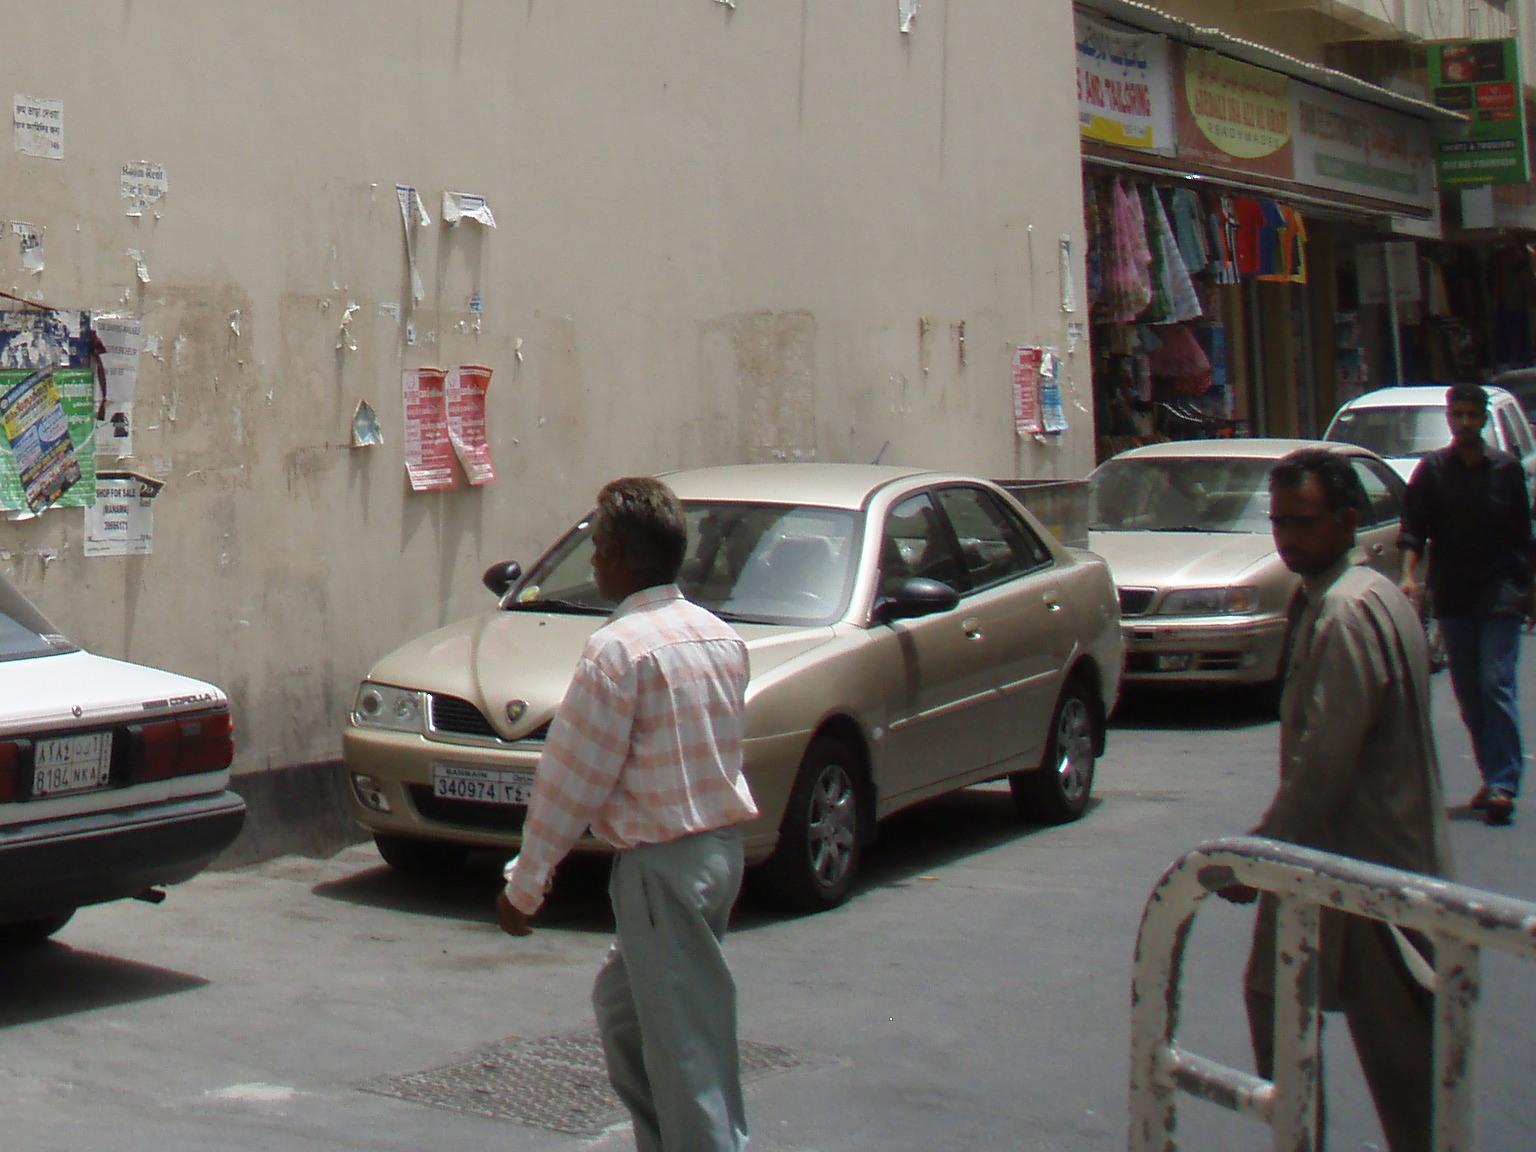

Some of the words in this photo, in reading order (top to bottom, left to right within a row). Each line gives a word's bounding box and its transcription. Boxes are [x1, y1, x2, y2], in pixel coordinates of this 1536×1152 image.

[1105, 78, 1152, 117] TAILORING
[111, 488, 121, 498] FOR
[123, 488, 136, 498] SALE
[169, 693, 213, 705] COROLLA
[36, 768, 68, 791] 8184
[73, 766, 97, 783] NKA
[439, 779, 496, 800] 340974
